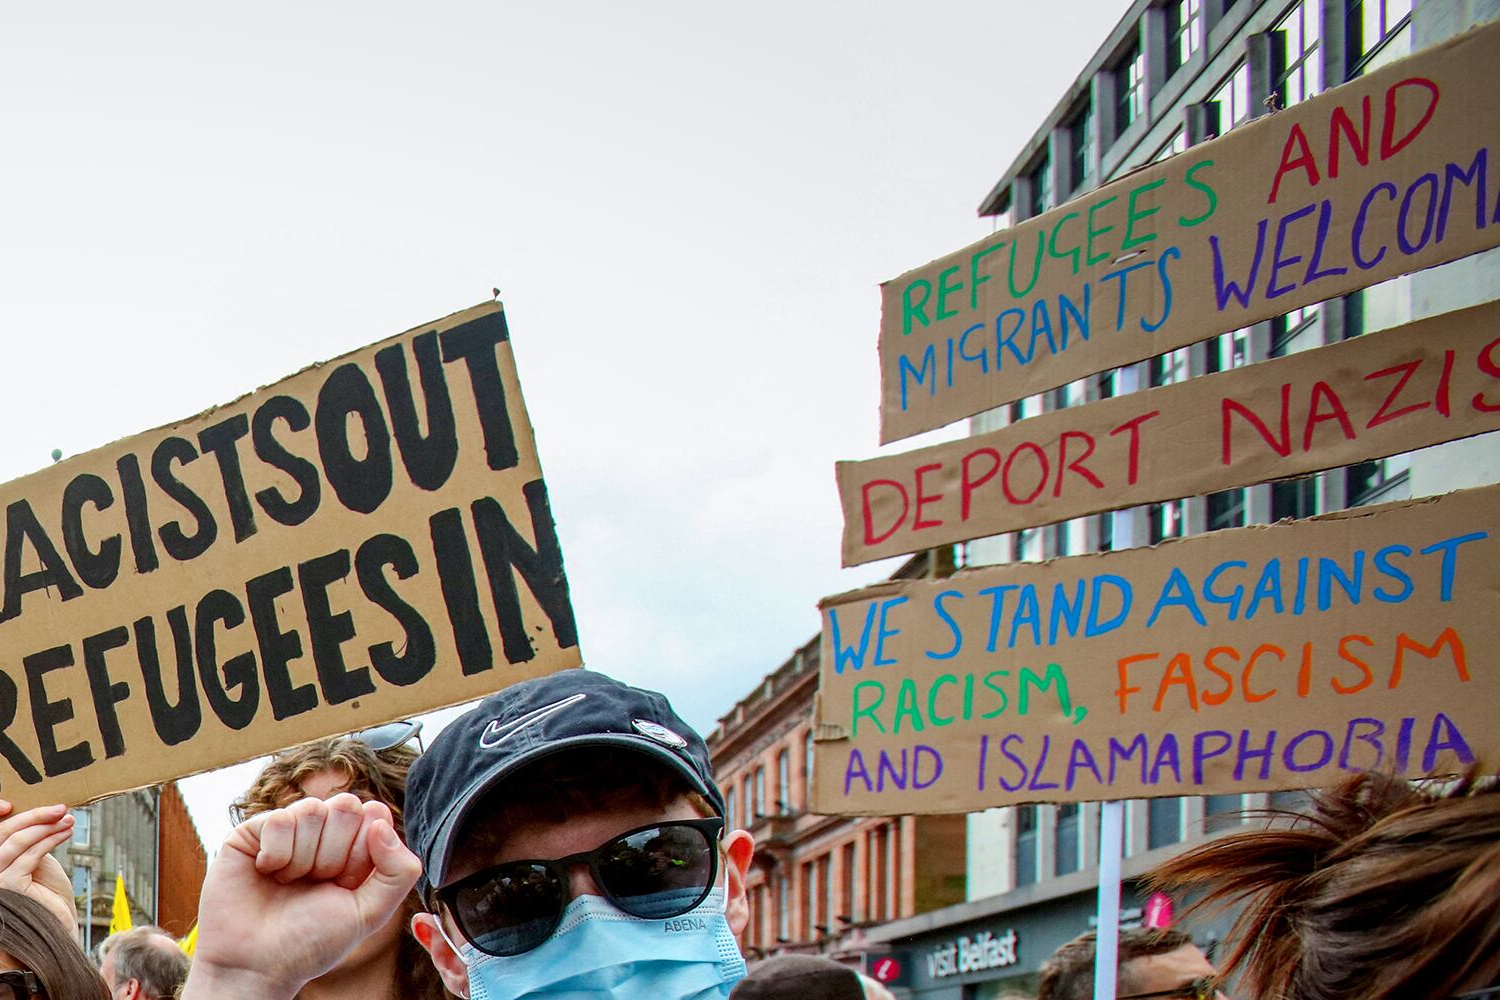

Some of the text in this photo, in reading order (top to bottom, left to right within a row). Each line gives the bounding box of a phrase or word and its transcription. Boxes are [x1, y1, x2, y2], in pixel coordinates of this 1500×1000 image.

[902, 77, 1441, 336] REFUGEES AND
[898, 147, 1500, 412] MIGRANTS WELCOM
[861, 409, 1160, 547] DEPORT
[828, 530, 1489, 675] WE STAND AGAINST
[851, 626, 1471, 740] RACISM, FASCISM
[843, 712, 1477, 796] AND ISLAMAPHOBIA
[664, 918, 707, 933] ABENA
[957, 928, 1019, 973] Belfast
